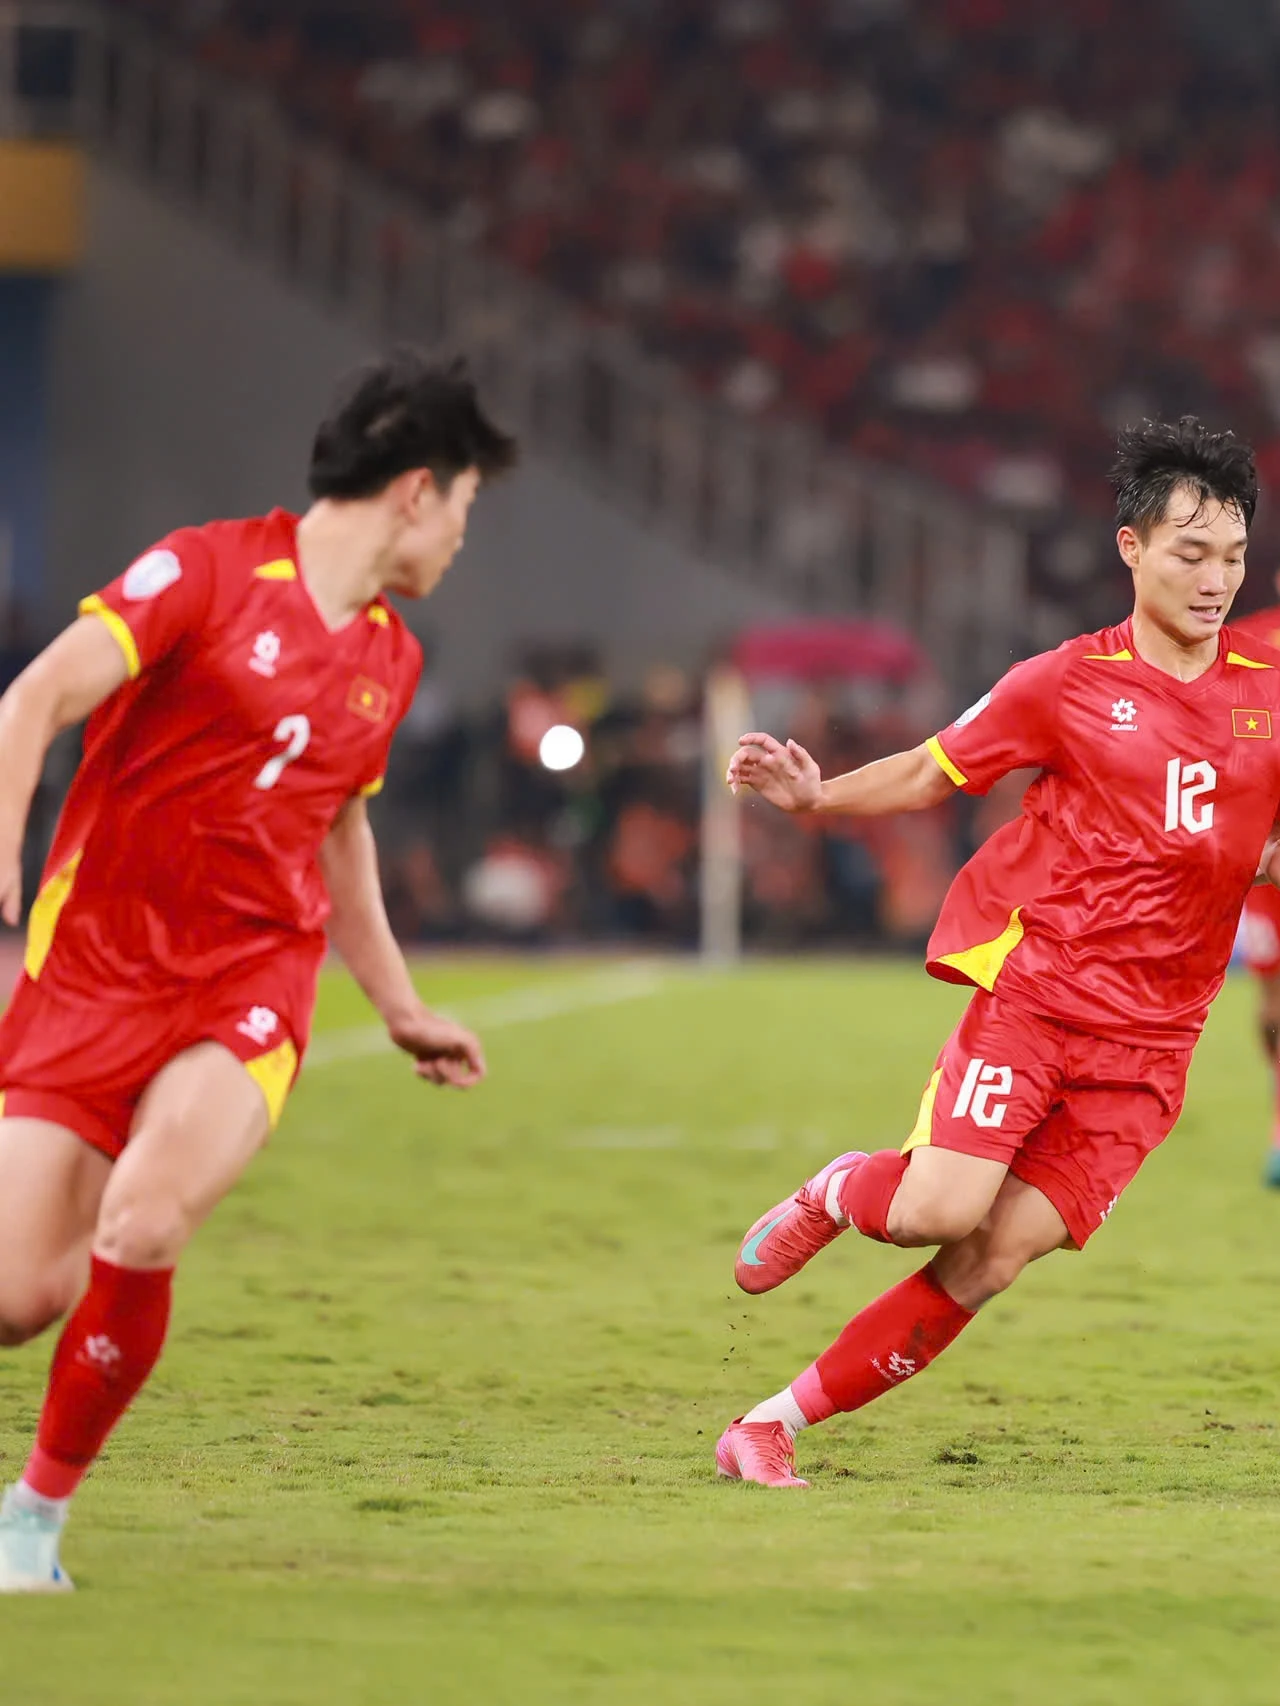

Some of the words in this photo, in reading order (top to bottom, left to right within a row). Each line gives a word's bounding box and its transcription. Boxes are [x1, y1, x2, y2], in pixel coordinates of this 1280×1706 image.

[252, 713, 311, 791] 2
[1164, 756, 1217, 835] 12
[951, 1058, 1013, 1128] 12
